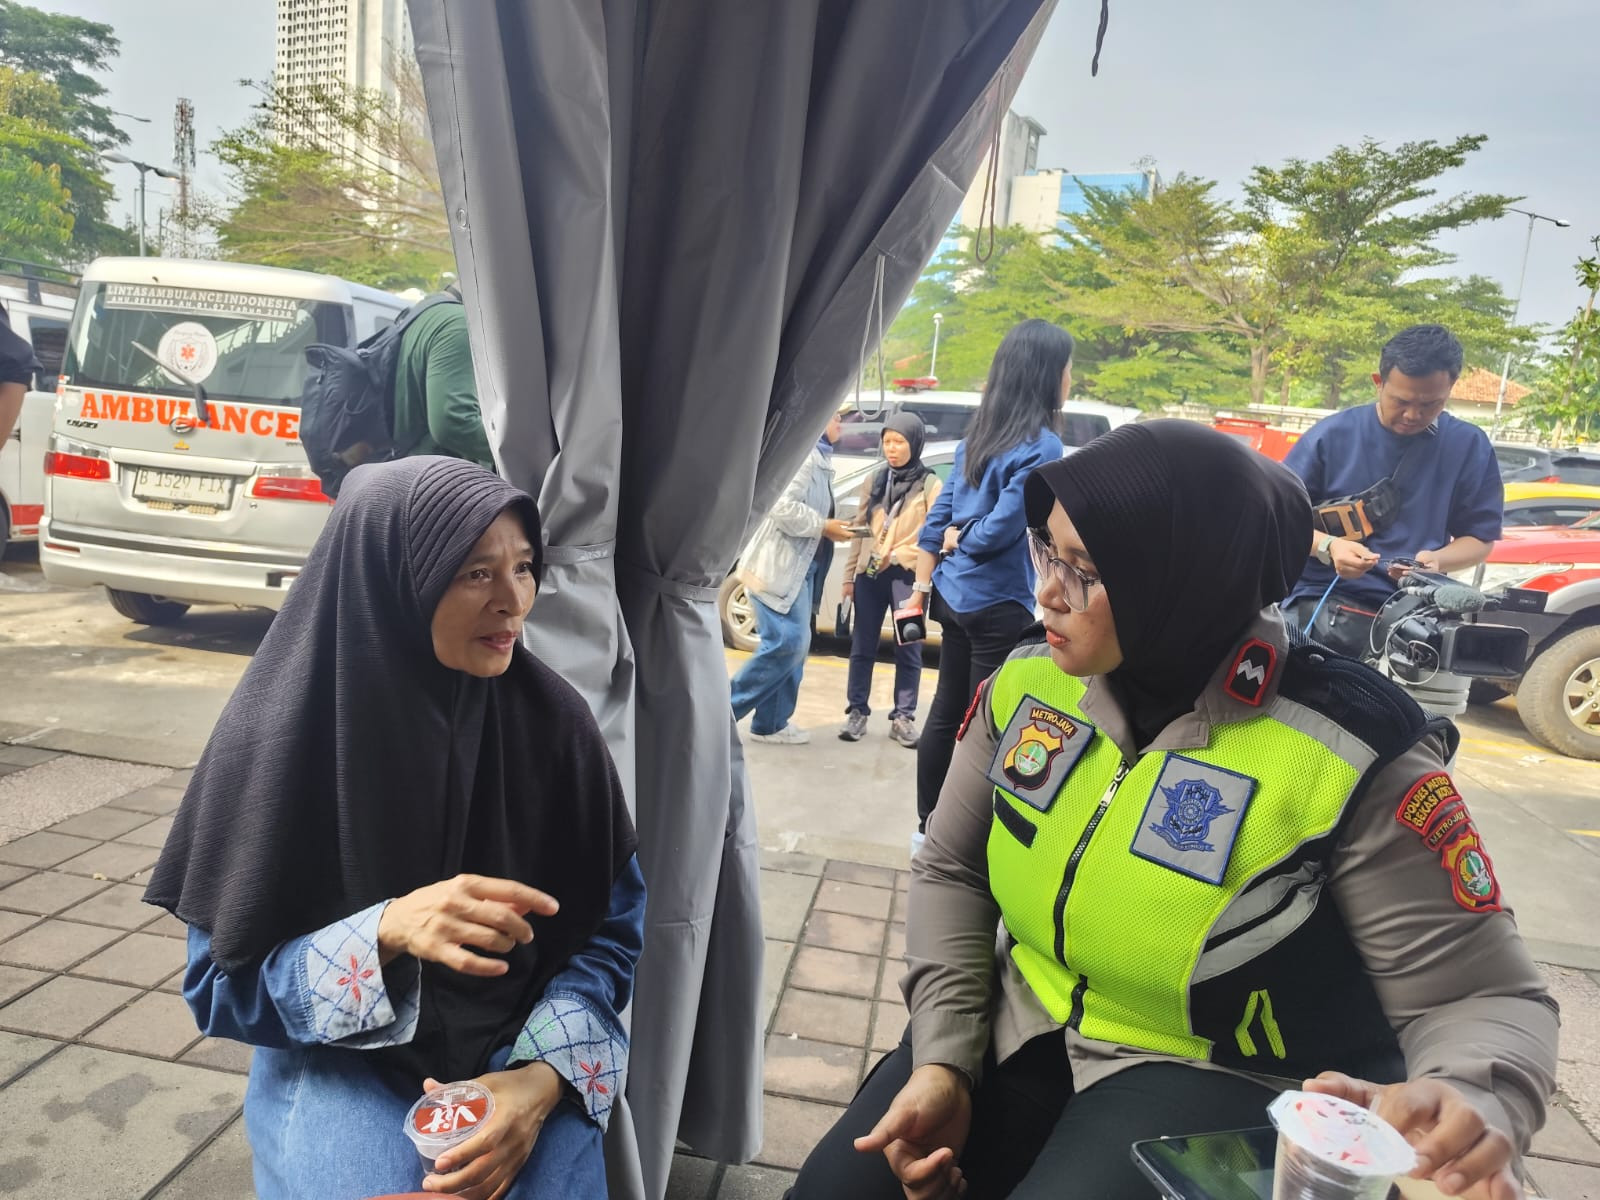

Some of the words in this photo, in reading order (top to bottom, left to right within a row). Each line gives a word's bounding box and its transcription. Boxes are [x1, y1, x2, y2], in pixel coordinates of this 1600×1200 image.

[80, 392, 300, 440] AMBULANCE
[140, 468, 149, 485] B
[199, 475, 225, 494] FIX
